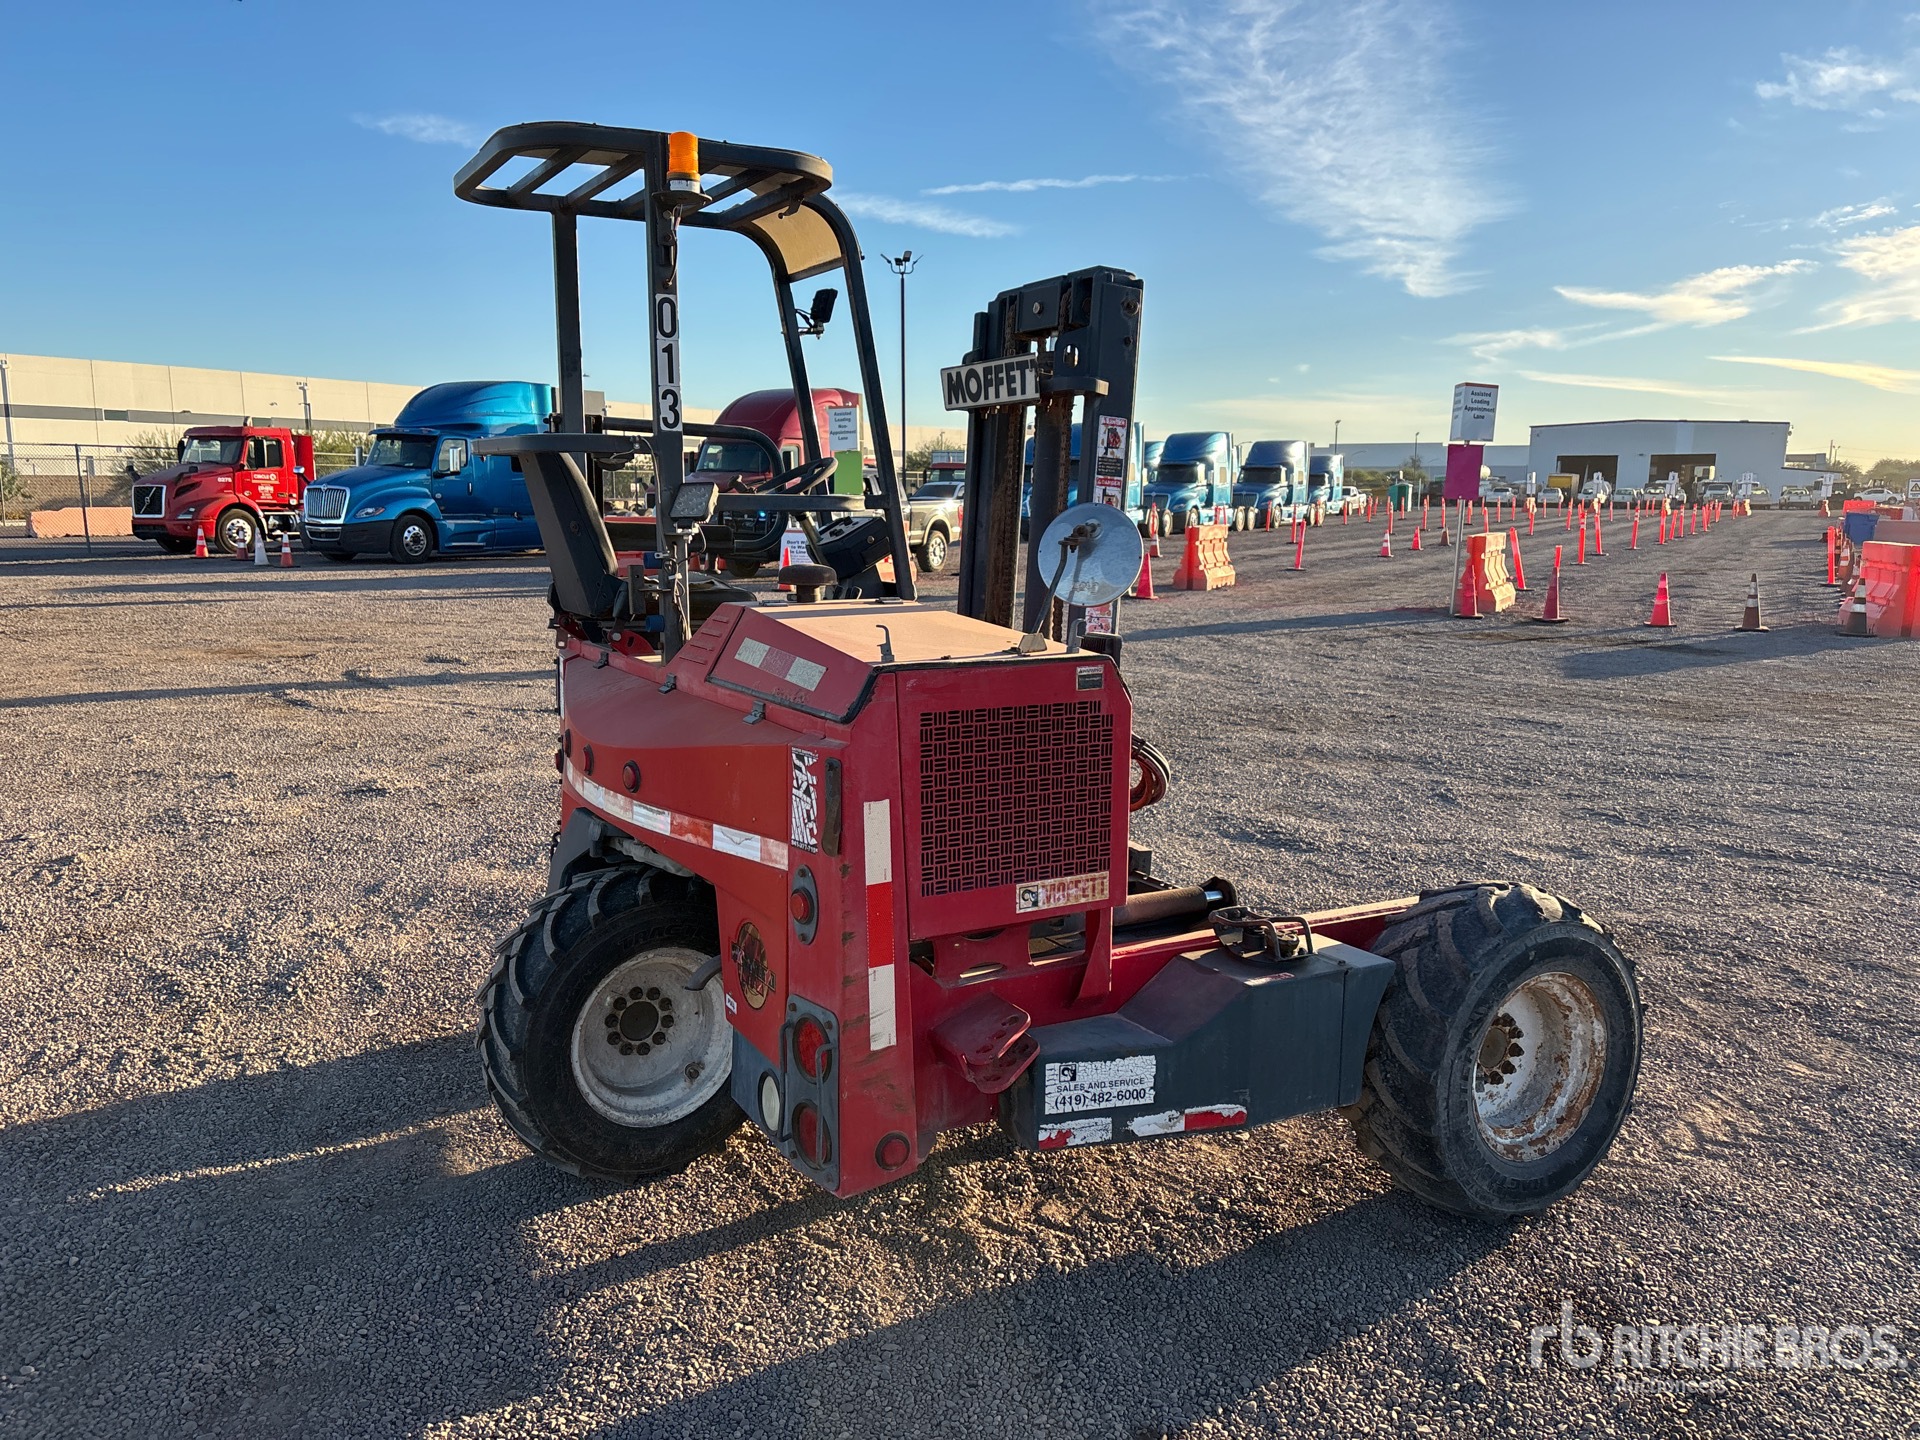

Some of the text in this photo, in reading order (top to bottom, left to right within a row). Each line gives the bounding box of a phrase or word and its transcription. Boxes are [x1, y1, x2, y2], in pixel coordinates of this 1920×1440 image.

[657, 296, 680, 429] 013
[1470, 390, 1492, 398] Assisted
[1471, 398, 1490, 406] Loading
[1464, 404, 1496, 413] Appointment
[1056, 1077, 1146, 1093] SALES AND SERVICE
[1054, 1088, 1147, 1110] (419) 482-6000
